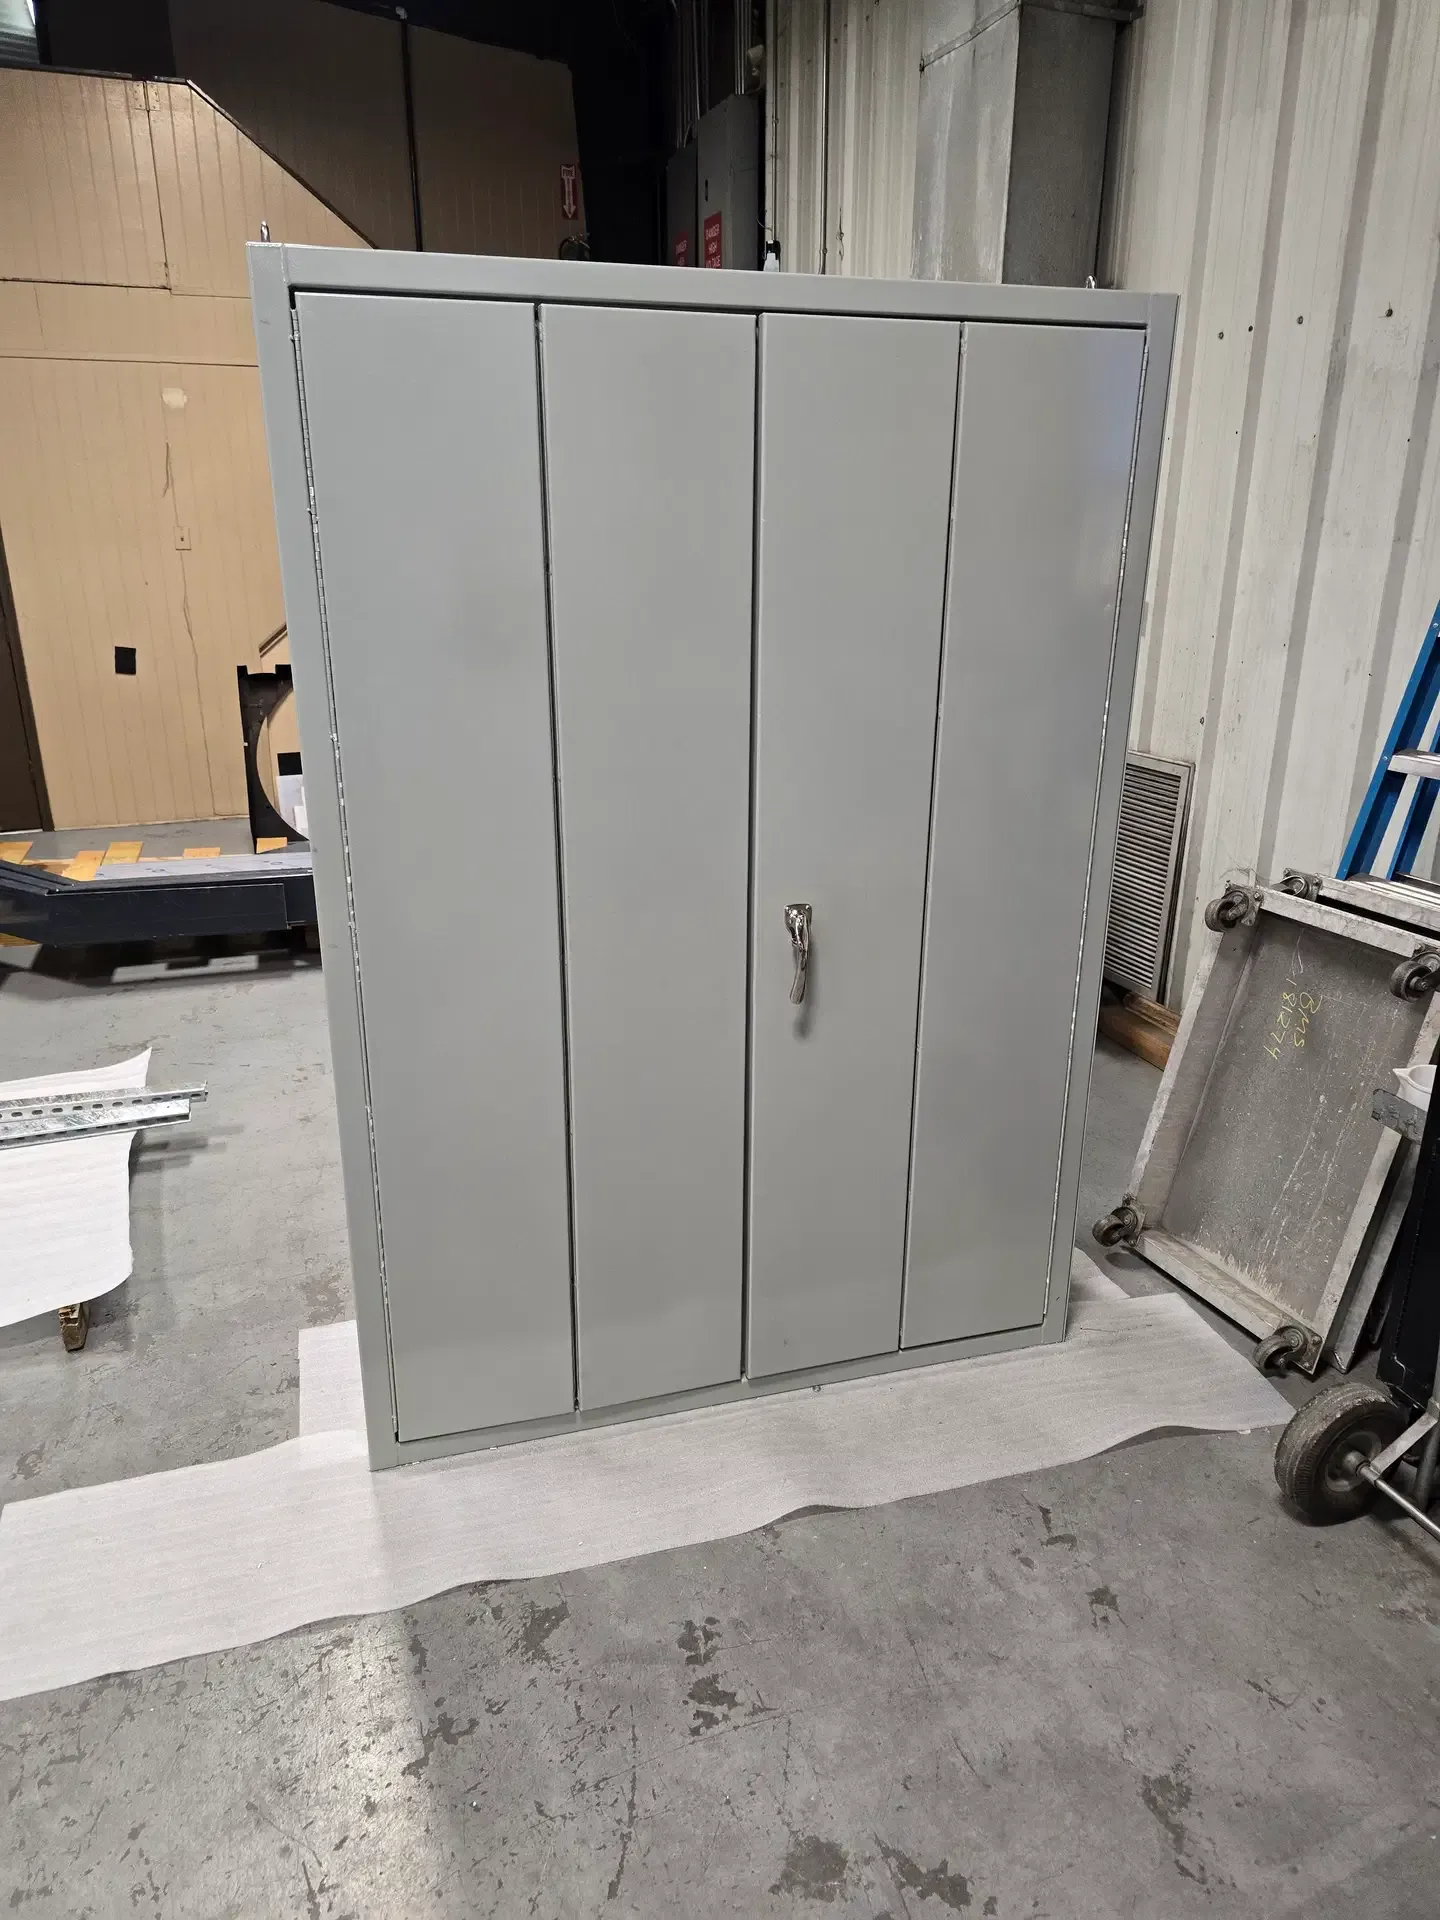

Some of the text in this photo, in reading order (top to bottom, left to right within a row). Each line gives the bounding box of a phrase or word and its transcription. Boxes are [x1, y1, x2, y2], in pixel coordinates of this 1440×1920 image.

[706, 223, 720, 240] DANGER
[708, 240, 718, 255] HIGH
[1263, 978, 1298, 1060] 181274
[1293, 991, 1323, 1048] BMS
